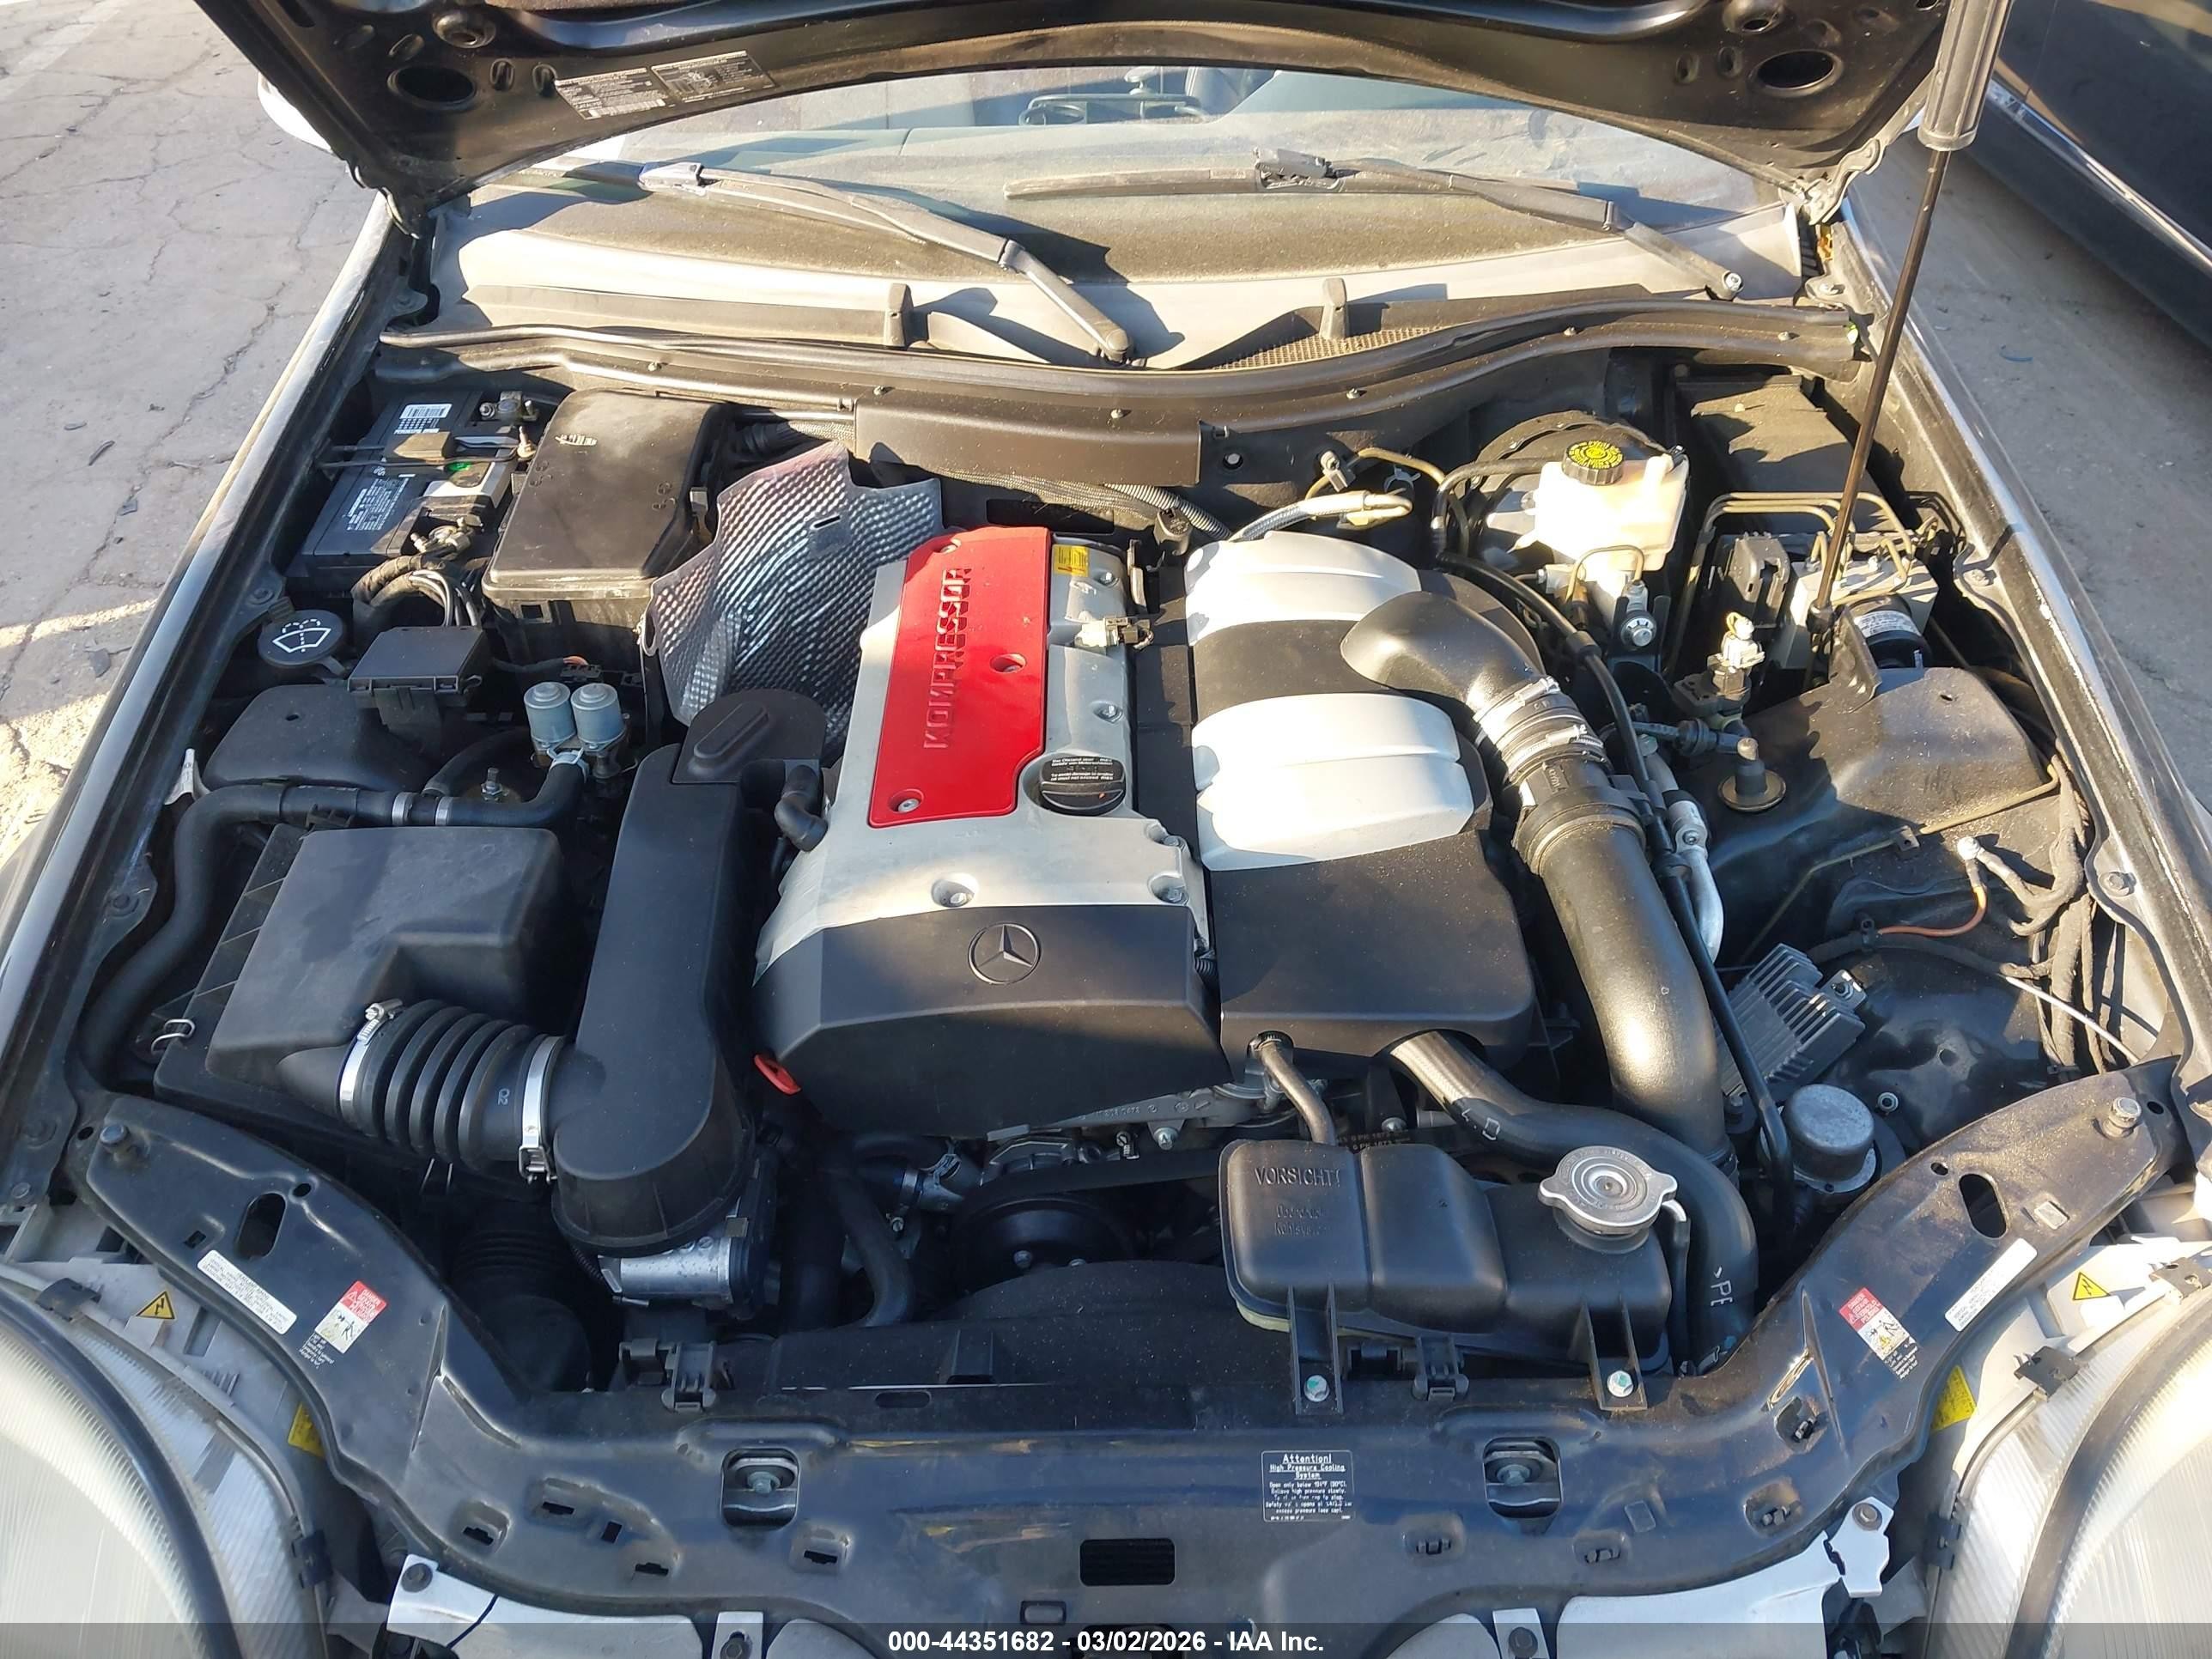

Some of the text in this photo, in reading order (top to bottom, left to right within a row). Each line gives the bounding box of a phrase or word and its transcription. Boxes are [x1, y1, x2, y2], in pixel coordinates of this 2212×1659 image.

[923, 567, 970, 750] KOMPRESSOR
[1254, 1166, 1341, 1188] VORSICHT!
[1282, 1453, 1332, 1464] Attention!
[1269, 1463, 1346, 1473] High Pressure Cooling
[1295, 1471, 1321, 1480] System
